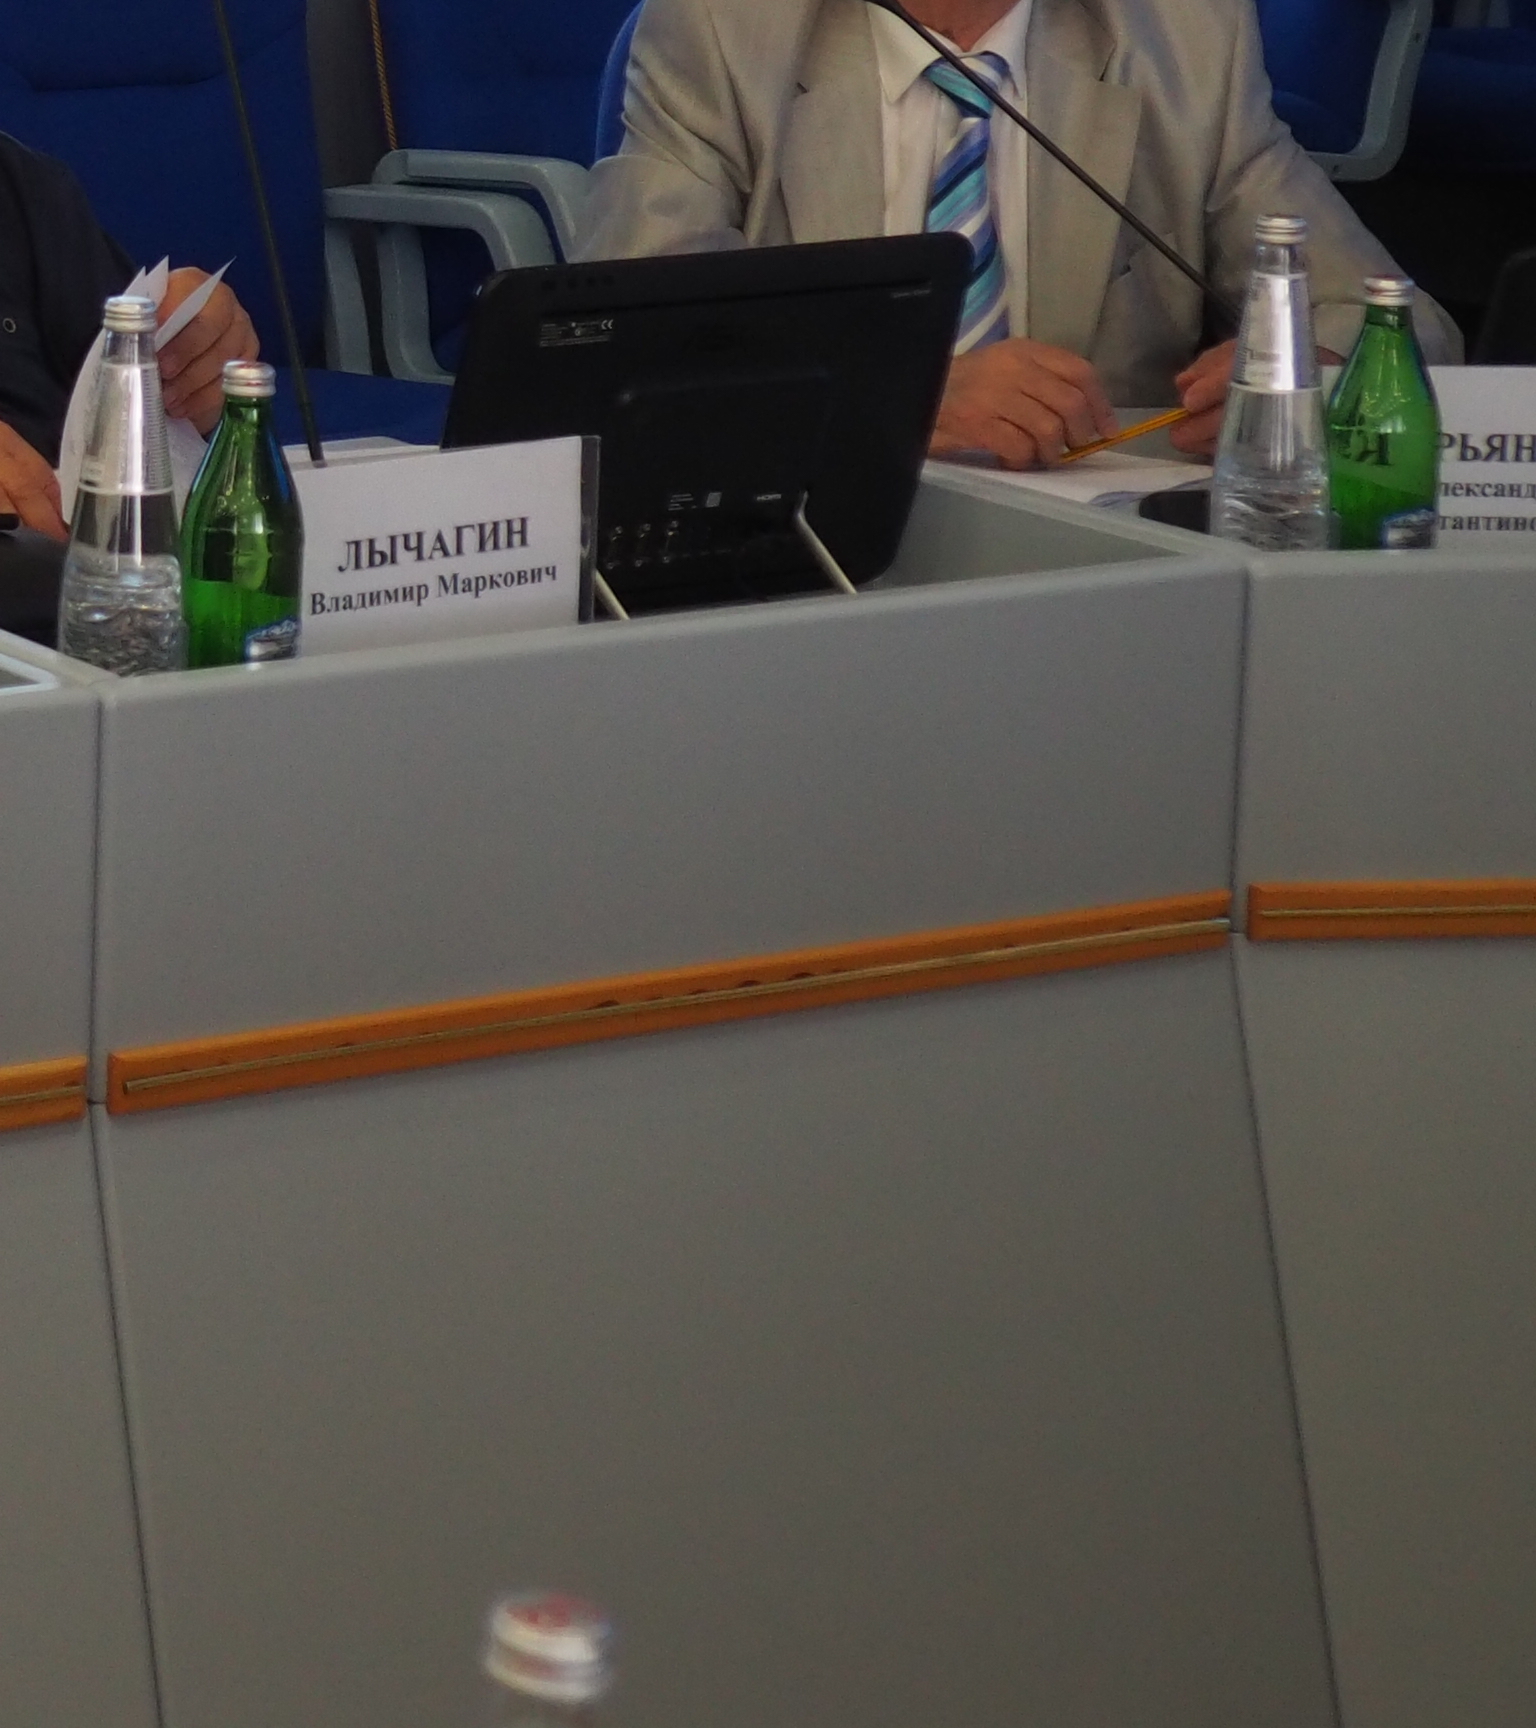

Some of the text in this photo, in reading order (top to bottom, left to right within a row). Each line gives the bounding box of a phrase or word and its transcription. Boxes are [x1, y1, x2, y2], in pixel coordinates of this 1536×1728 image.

[337, 516, 530, 573] ЛЫЧАГИН
[310, 565, 558, 616] Владимир Маркович
